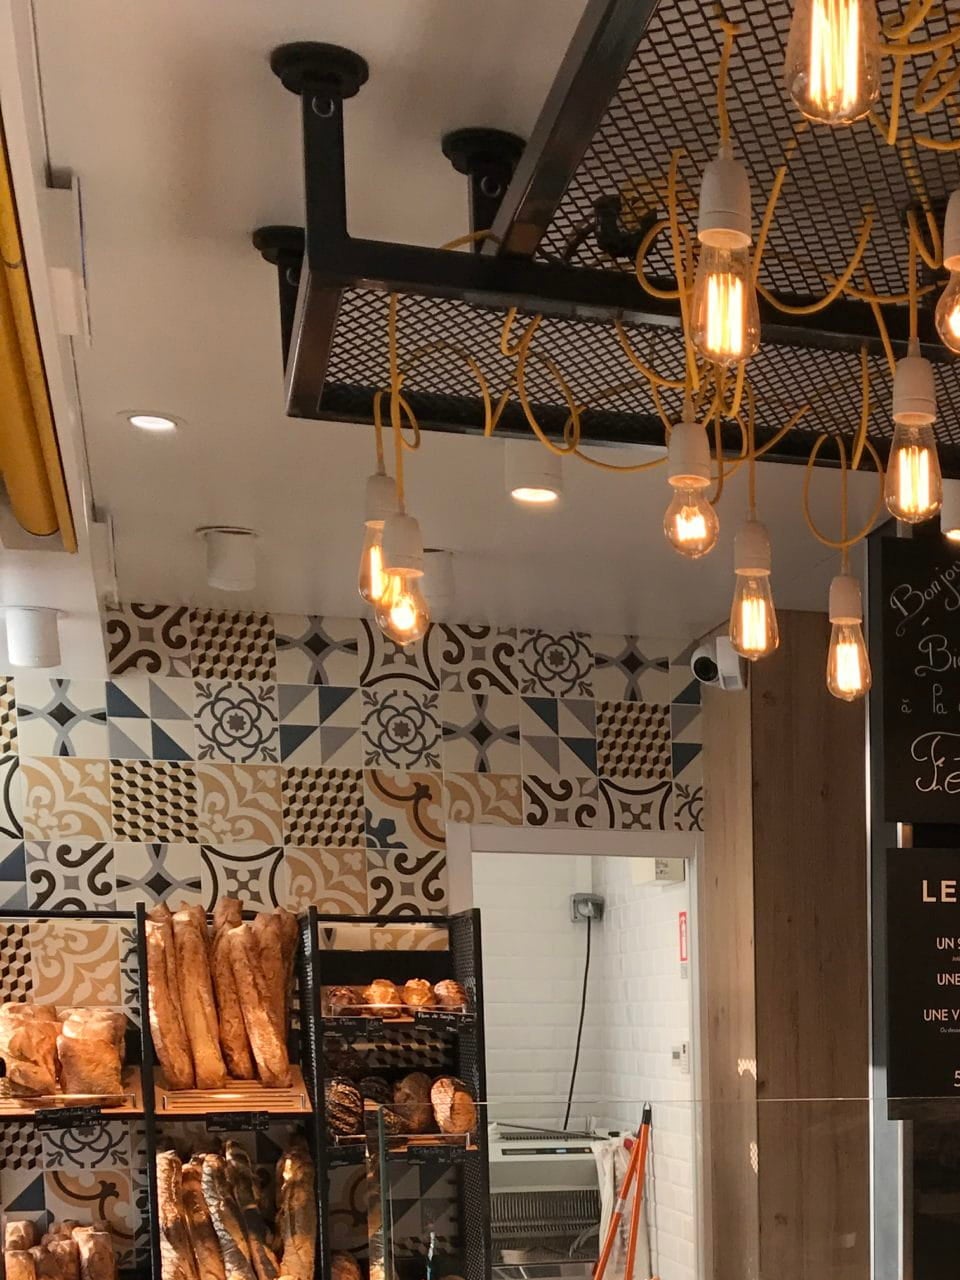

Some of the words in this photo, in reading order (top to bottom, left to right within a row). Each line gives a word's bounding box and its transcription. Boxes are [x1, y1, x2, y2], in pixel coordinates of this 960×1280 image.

[922, 879, 957, 903] LE
[936, 937, 955, 950] UN
[923, 1009, 949, 1021] UNE
